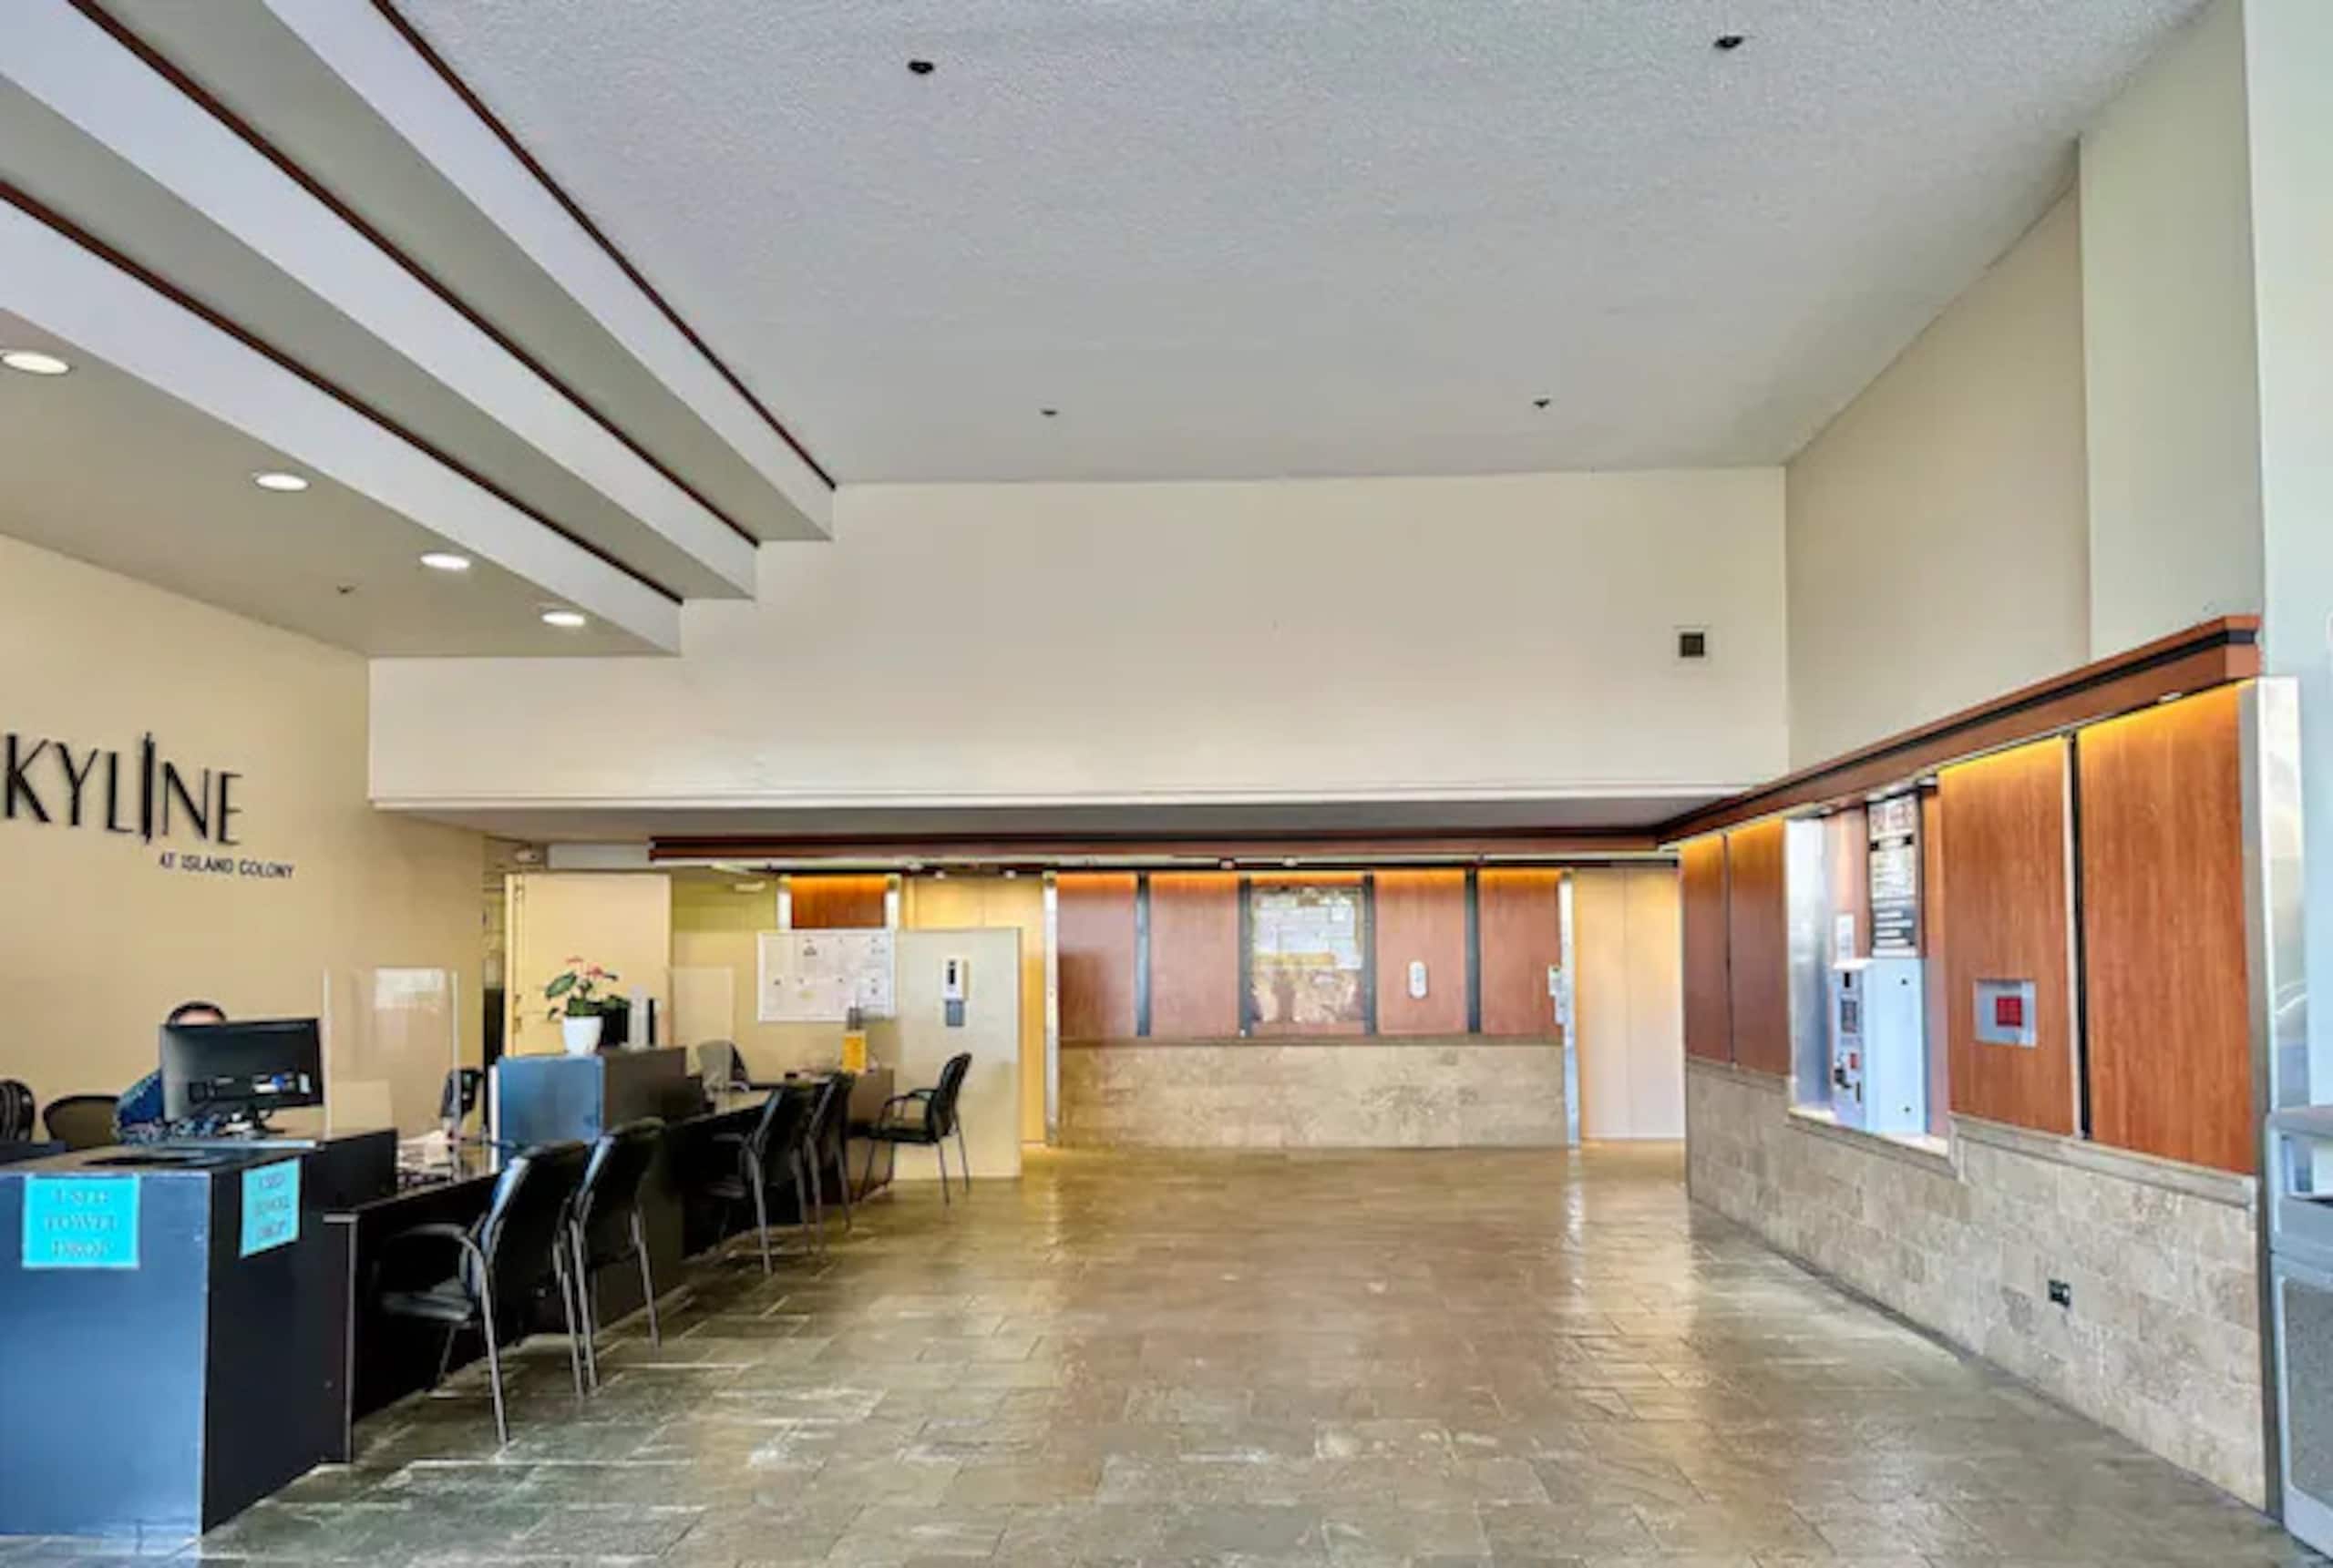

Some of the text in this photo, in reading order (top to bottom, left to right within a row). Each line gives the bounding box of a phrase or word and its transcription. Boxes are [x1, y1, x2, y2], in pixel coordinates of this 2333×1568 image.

[159, 851, 295, 879] AT ISLAND COLONY
